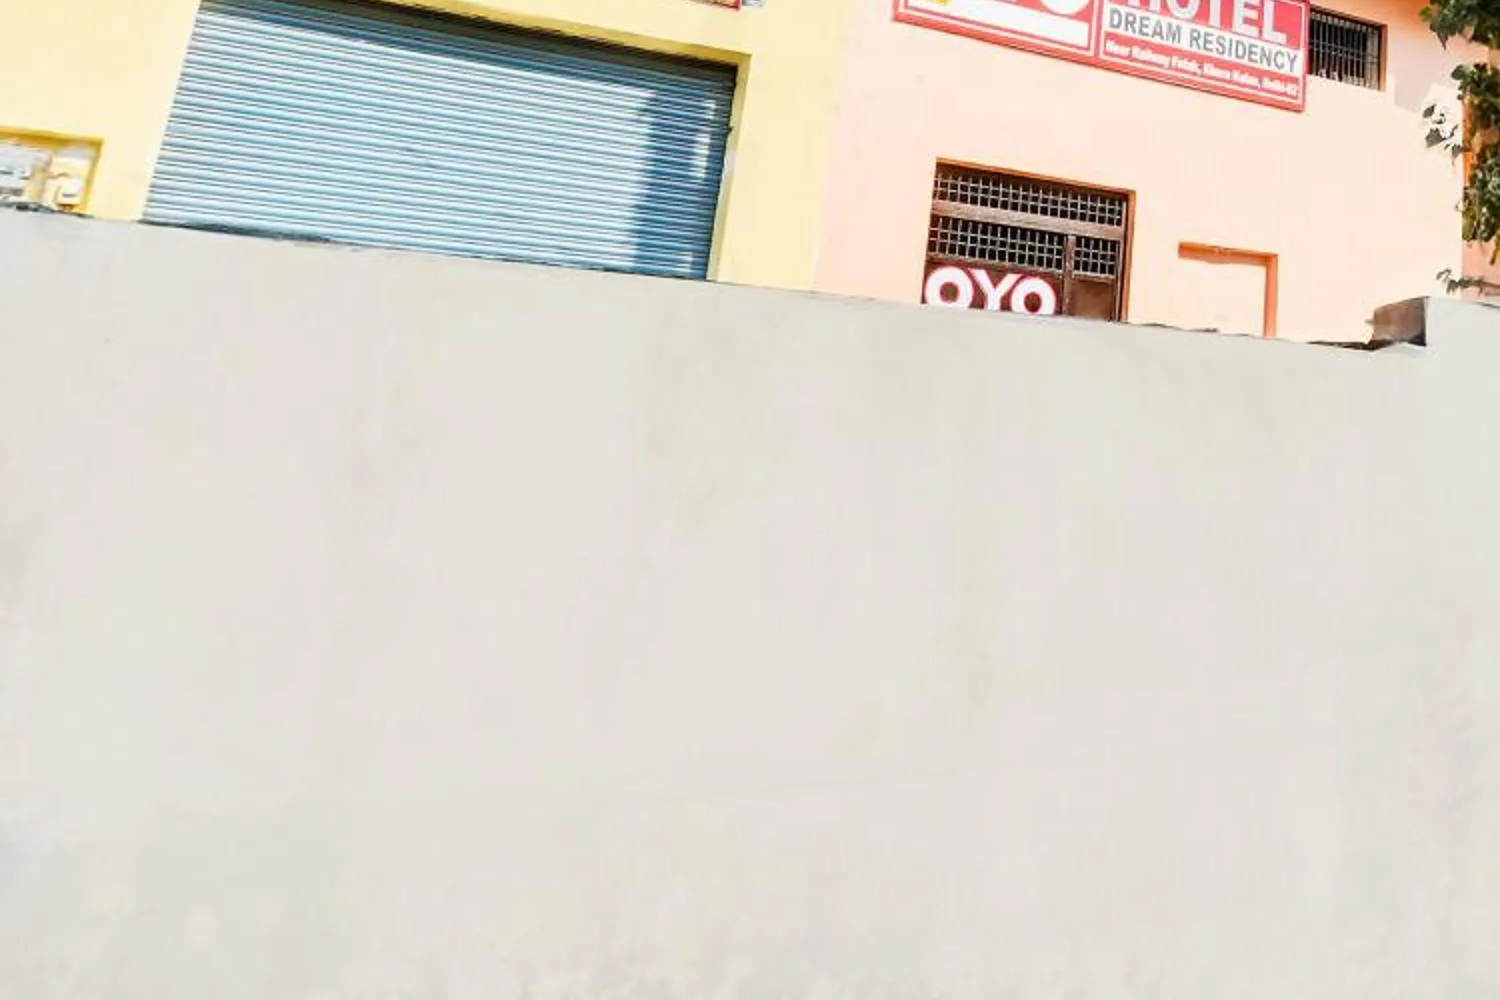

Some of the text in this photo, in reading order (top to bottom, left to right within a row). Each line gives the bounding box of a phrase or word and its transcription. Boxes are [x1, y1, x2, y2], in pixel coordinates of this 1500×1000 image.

[1109, 7, 1298, 73] DREAM RESIDENCY
[924, 265, 1056, 315] OYO
